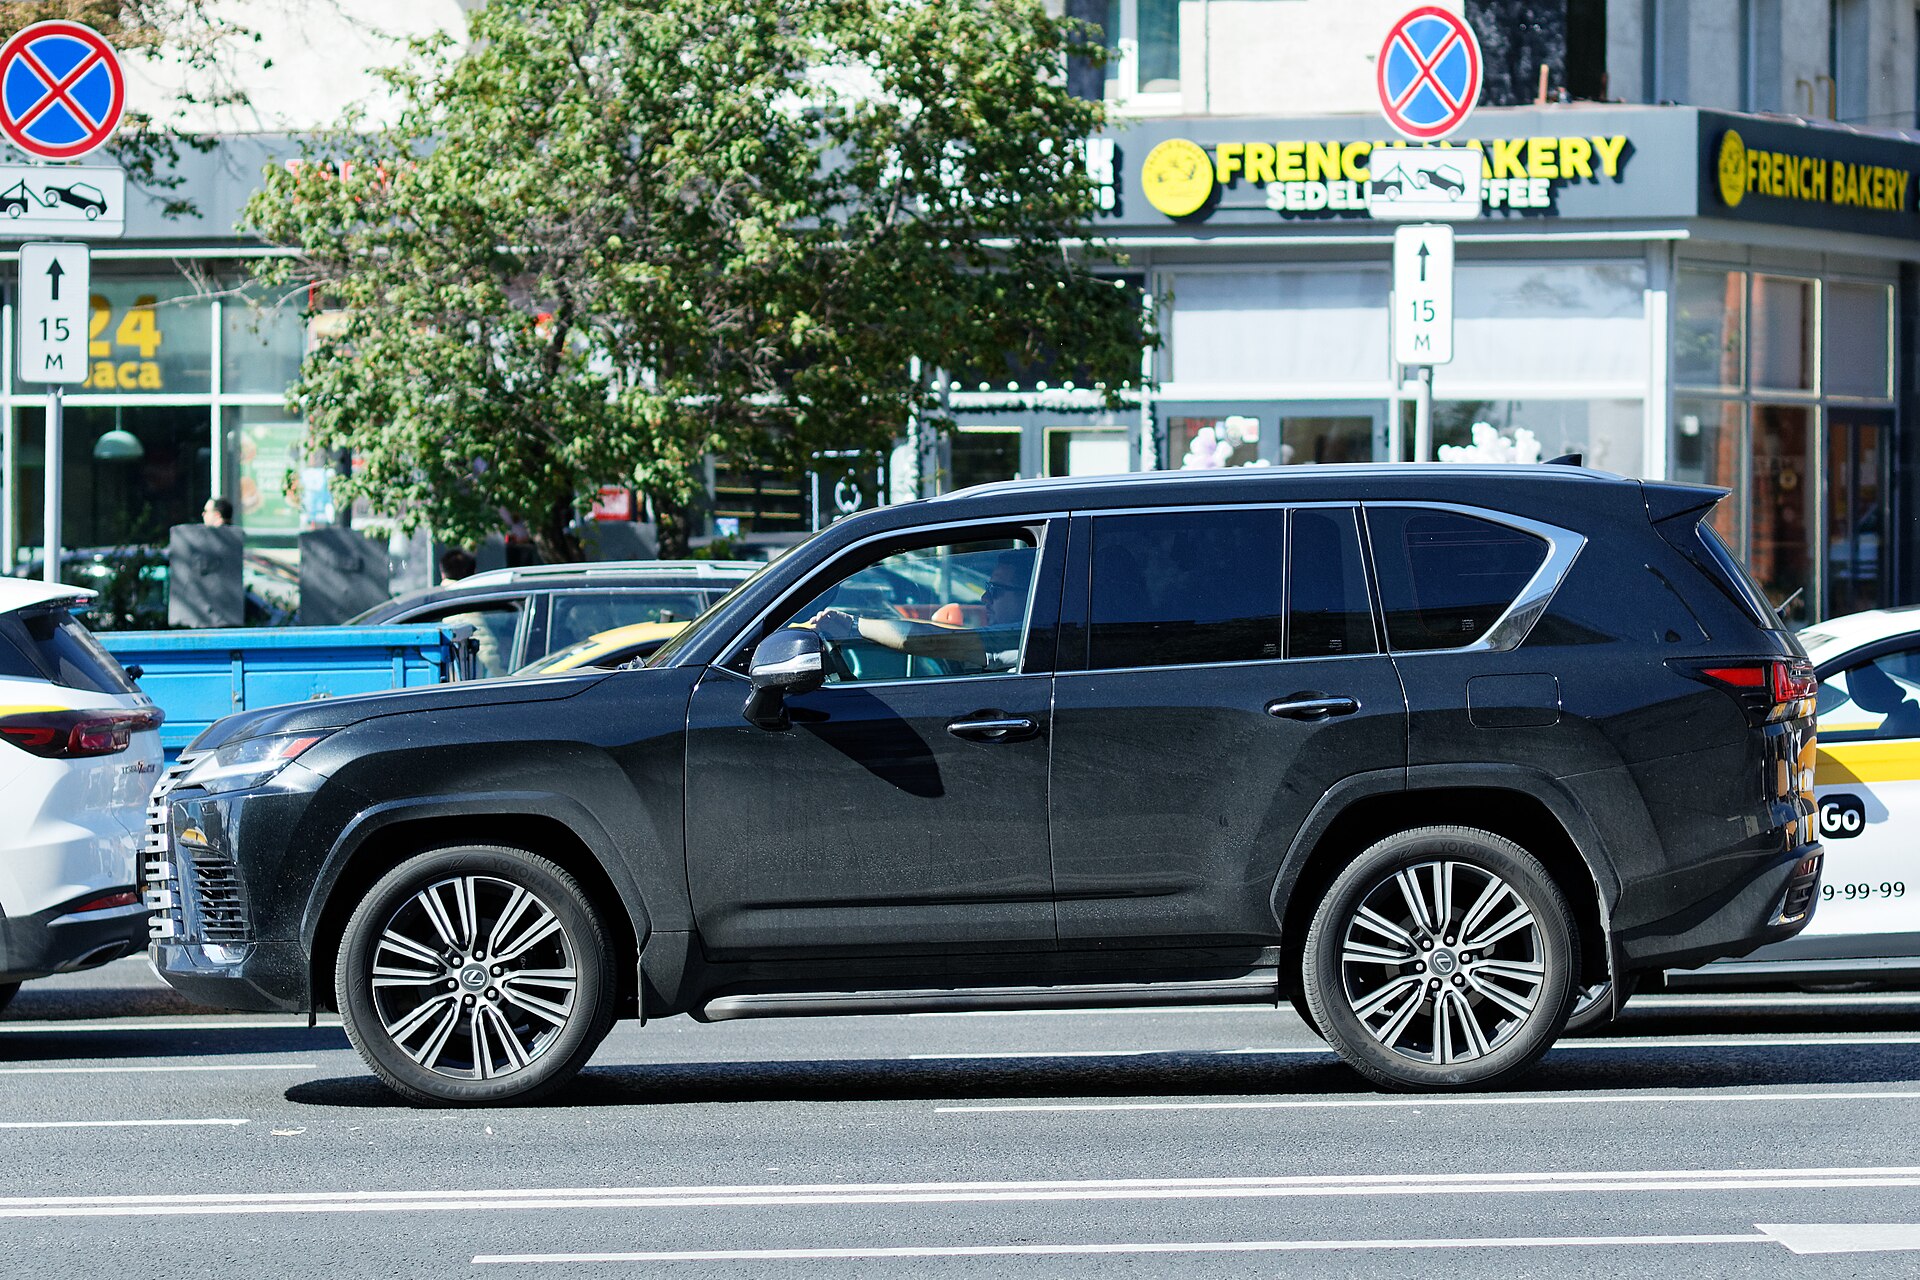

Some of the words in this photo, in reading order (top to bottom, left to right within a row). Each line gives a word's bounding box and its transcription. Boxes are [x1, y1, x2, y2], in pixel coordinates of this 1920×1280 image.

[1216, 140, 1406, 184] FRENC
[1423, 135, 1628, 179] KERY
[1747, 148, 1827, 201] FRENCH
[1832, 160, 1909, 212] BAKERY
[1412, 299, 1435, 322] 15
[39, 317, 70, 342] 15
[83, 361, 163, 389] аса
[1820, 802, 1861, 832] Go
[1440, 841, 1517, 876] YOKOHAMA
[493, 857, 564, 906] YOKOHAMA
[1820, 881, 1905, 901] 9-99-99
